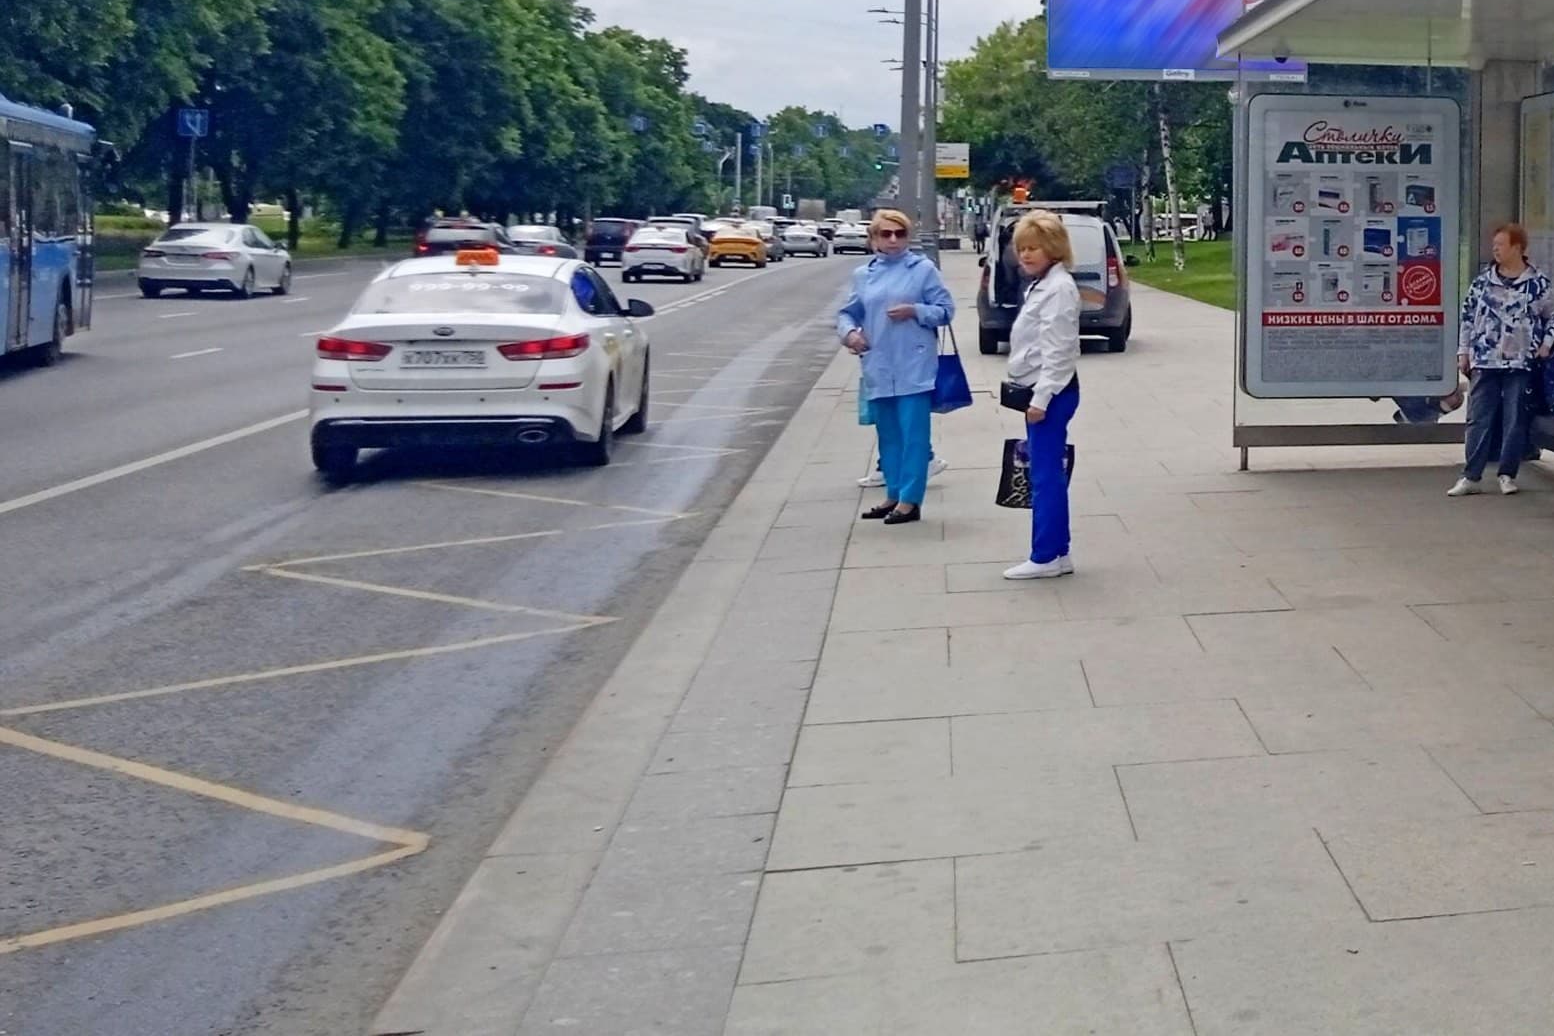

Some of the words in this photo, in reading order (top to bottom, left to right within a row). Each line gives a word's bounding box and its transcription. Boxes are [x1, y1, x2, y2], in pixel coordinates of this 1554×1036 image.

[1303, 120, 1406, 143] Столички
[1267, 315, 1312, 325] НИЗКИЕ
[1314, 315, 1345, 325] ЦЕНЫ
[1355, 315, 1382, 324] ШАГЕ
[1387, 315, 1402, 324] ОТ
[1403, 315, 1437, 325] ДОМА
